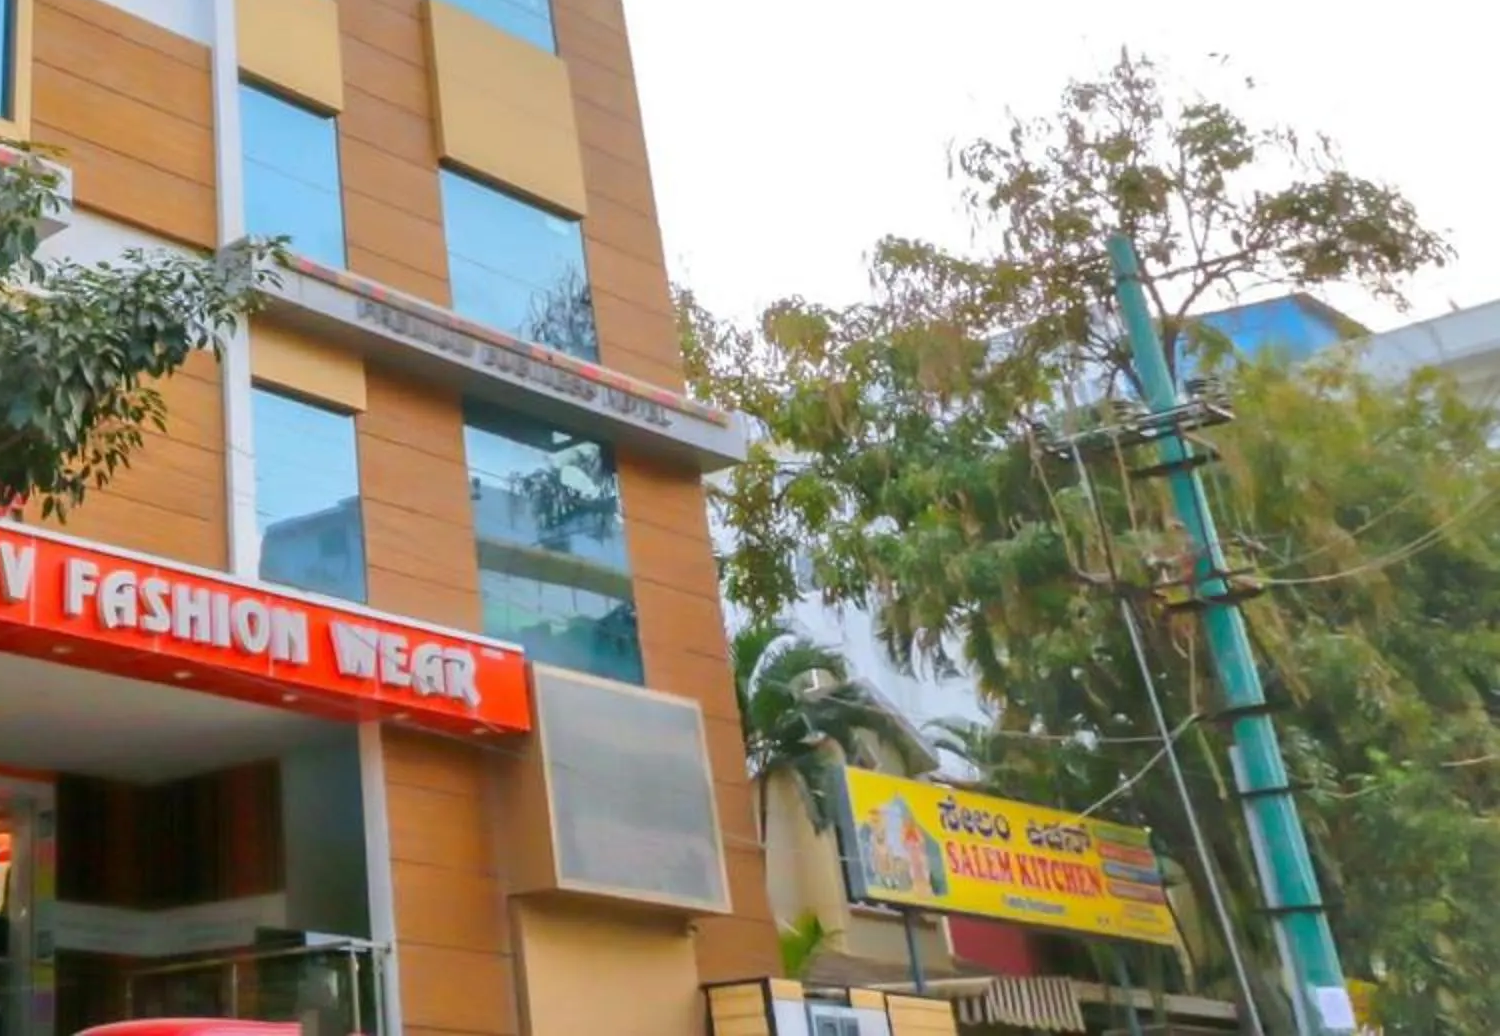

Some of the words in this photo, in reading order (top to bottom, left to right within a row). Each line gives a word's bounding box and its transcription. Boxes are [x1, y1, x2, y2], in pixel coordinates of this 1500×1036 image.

[65, 557, 308, 664] FASHION
[329, 621, 480, 708] WEAR
[945, 841, 1013, 883] SALEM
[1016, 854, 1104, 898] KITCHEN
